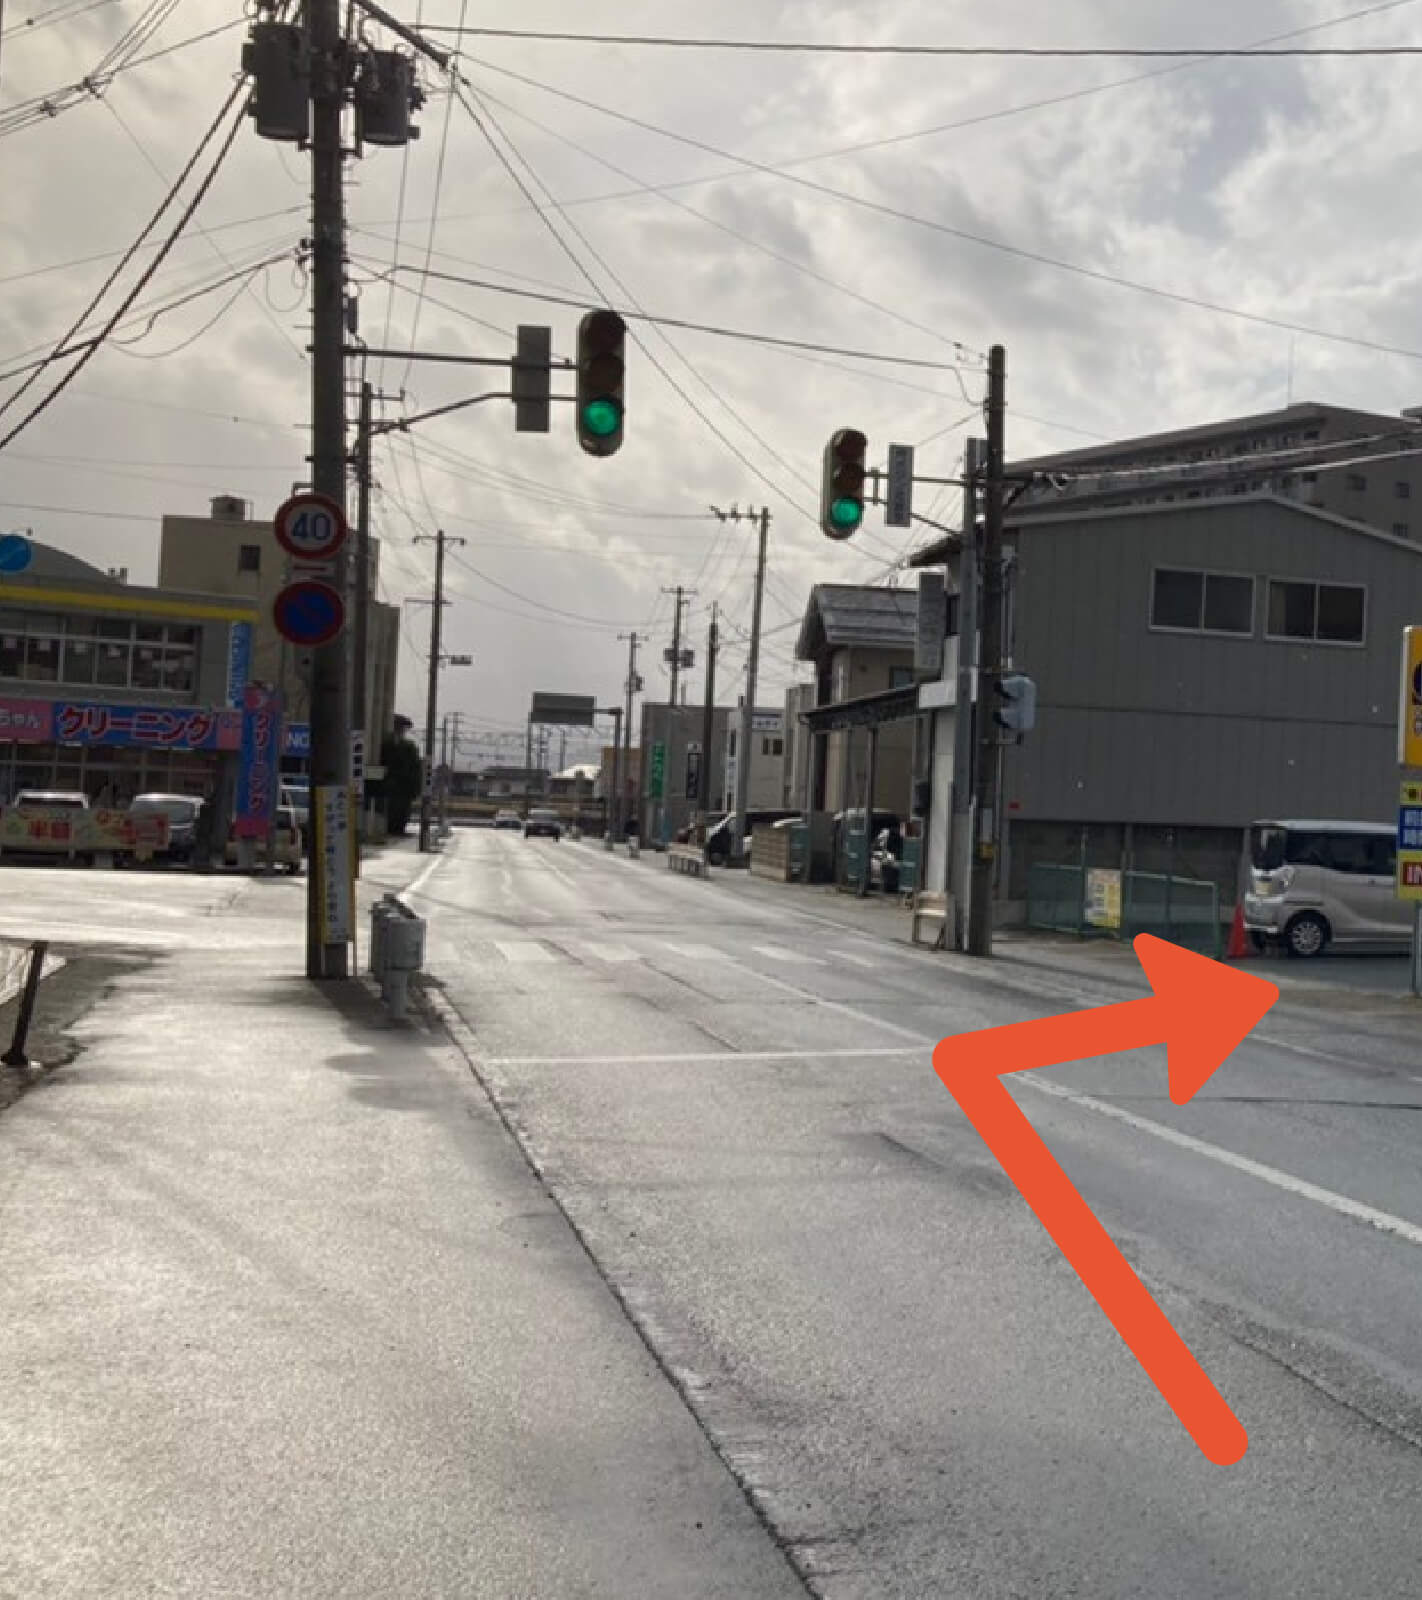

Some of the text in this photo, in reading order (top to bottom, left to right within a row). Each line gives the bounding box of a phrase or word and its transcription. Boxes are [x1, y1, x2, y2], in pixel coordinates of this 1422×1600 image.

[293, 513, 332, 539] 40
[57, 704, 214, 745] クリーニング
